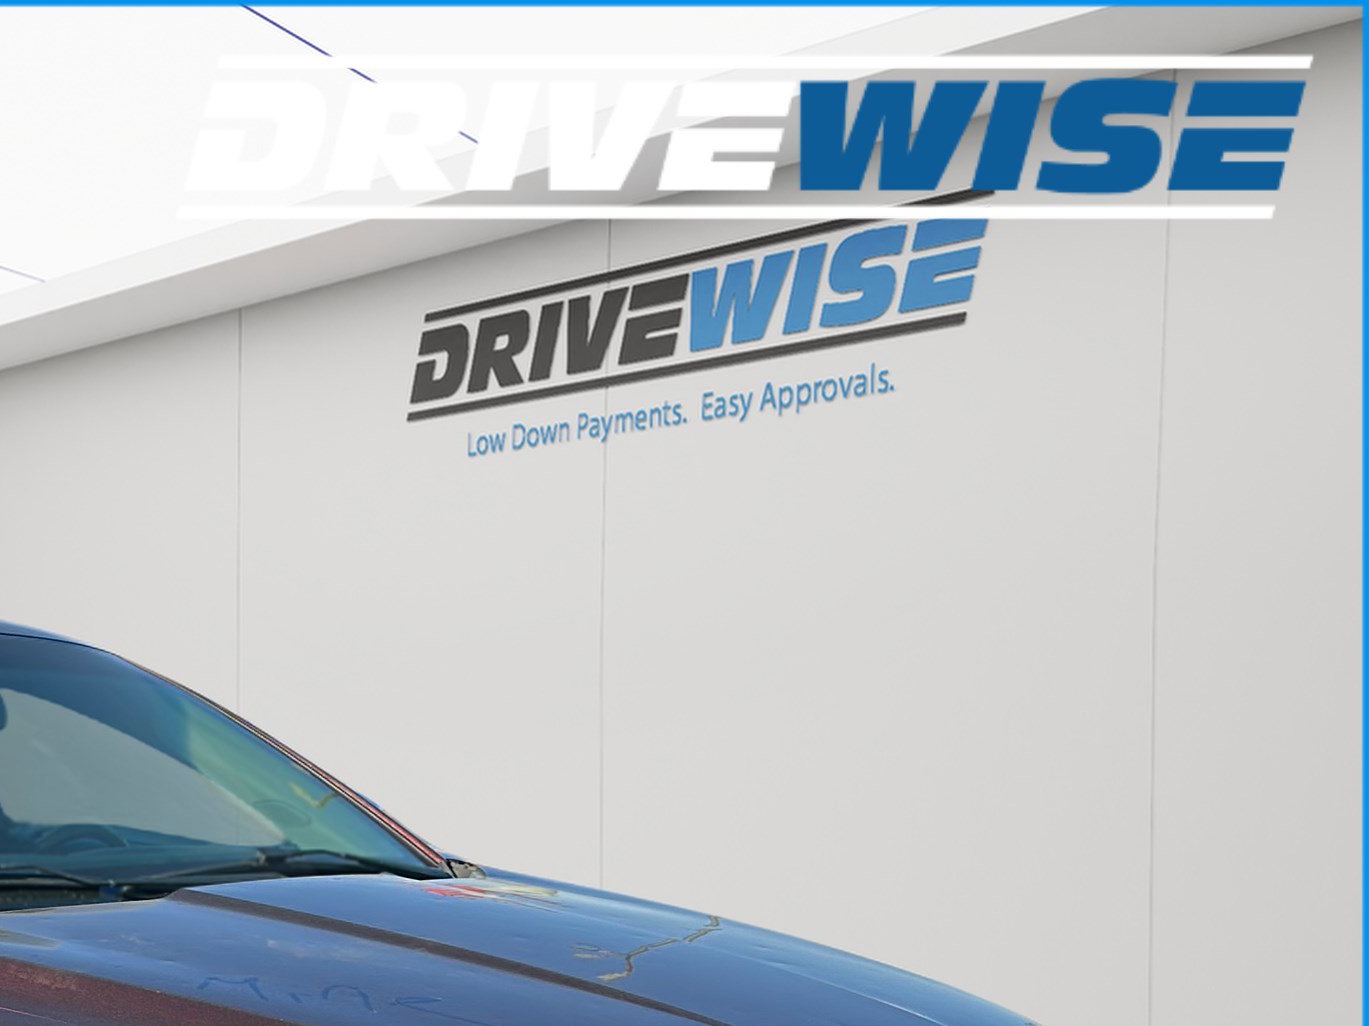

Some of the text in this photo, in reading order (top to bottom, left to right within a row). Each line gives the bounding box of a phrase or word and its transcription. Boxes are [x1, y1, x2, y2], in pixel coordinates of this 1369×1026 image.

[410, 214, 990, 404] DRIVEWISE
[466, 362, 896, 459] Low Down Payments. Easy Approvals.
